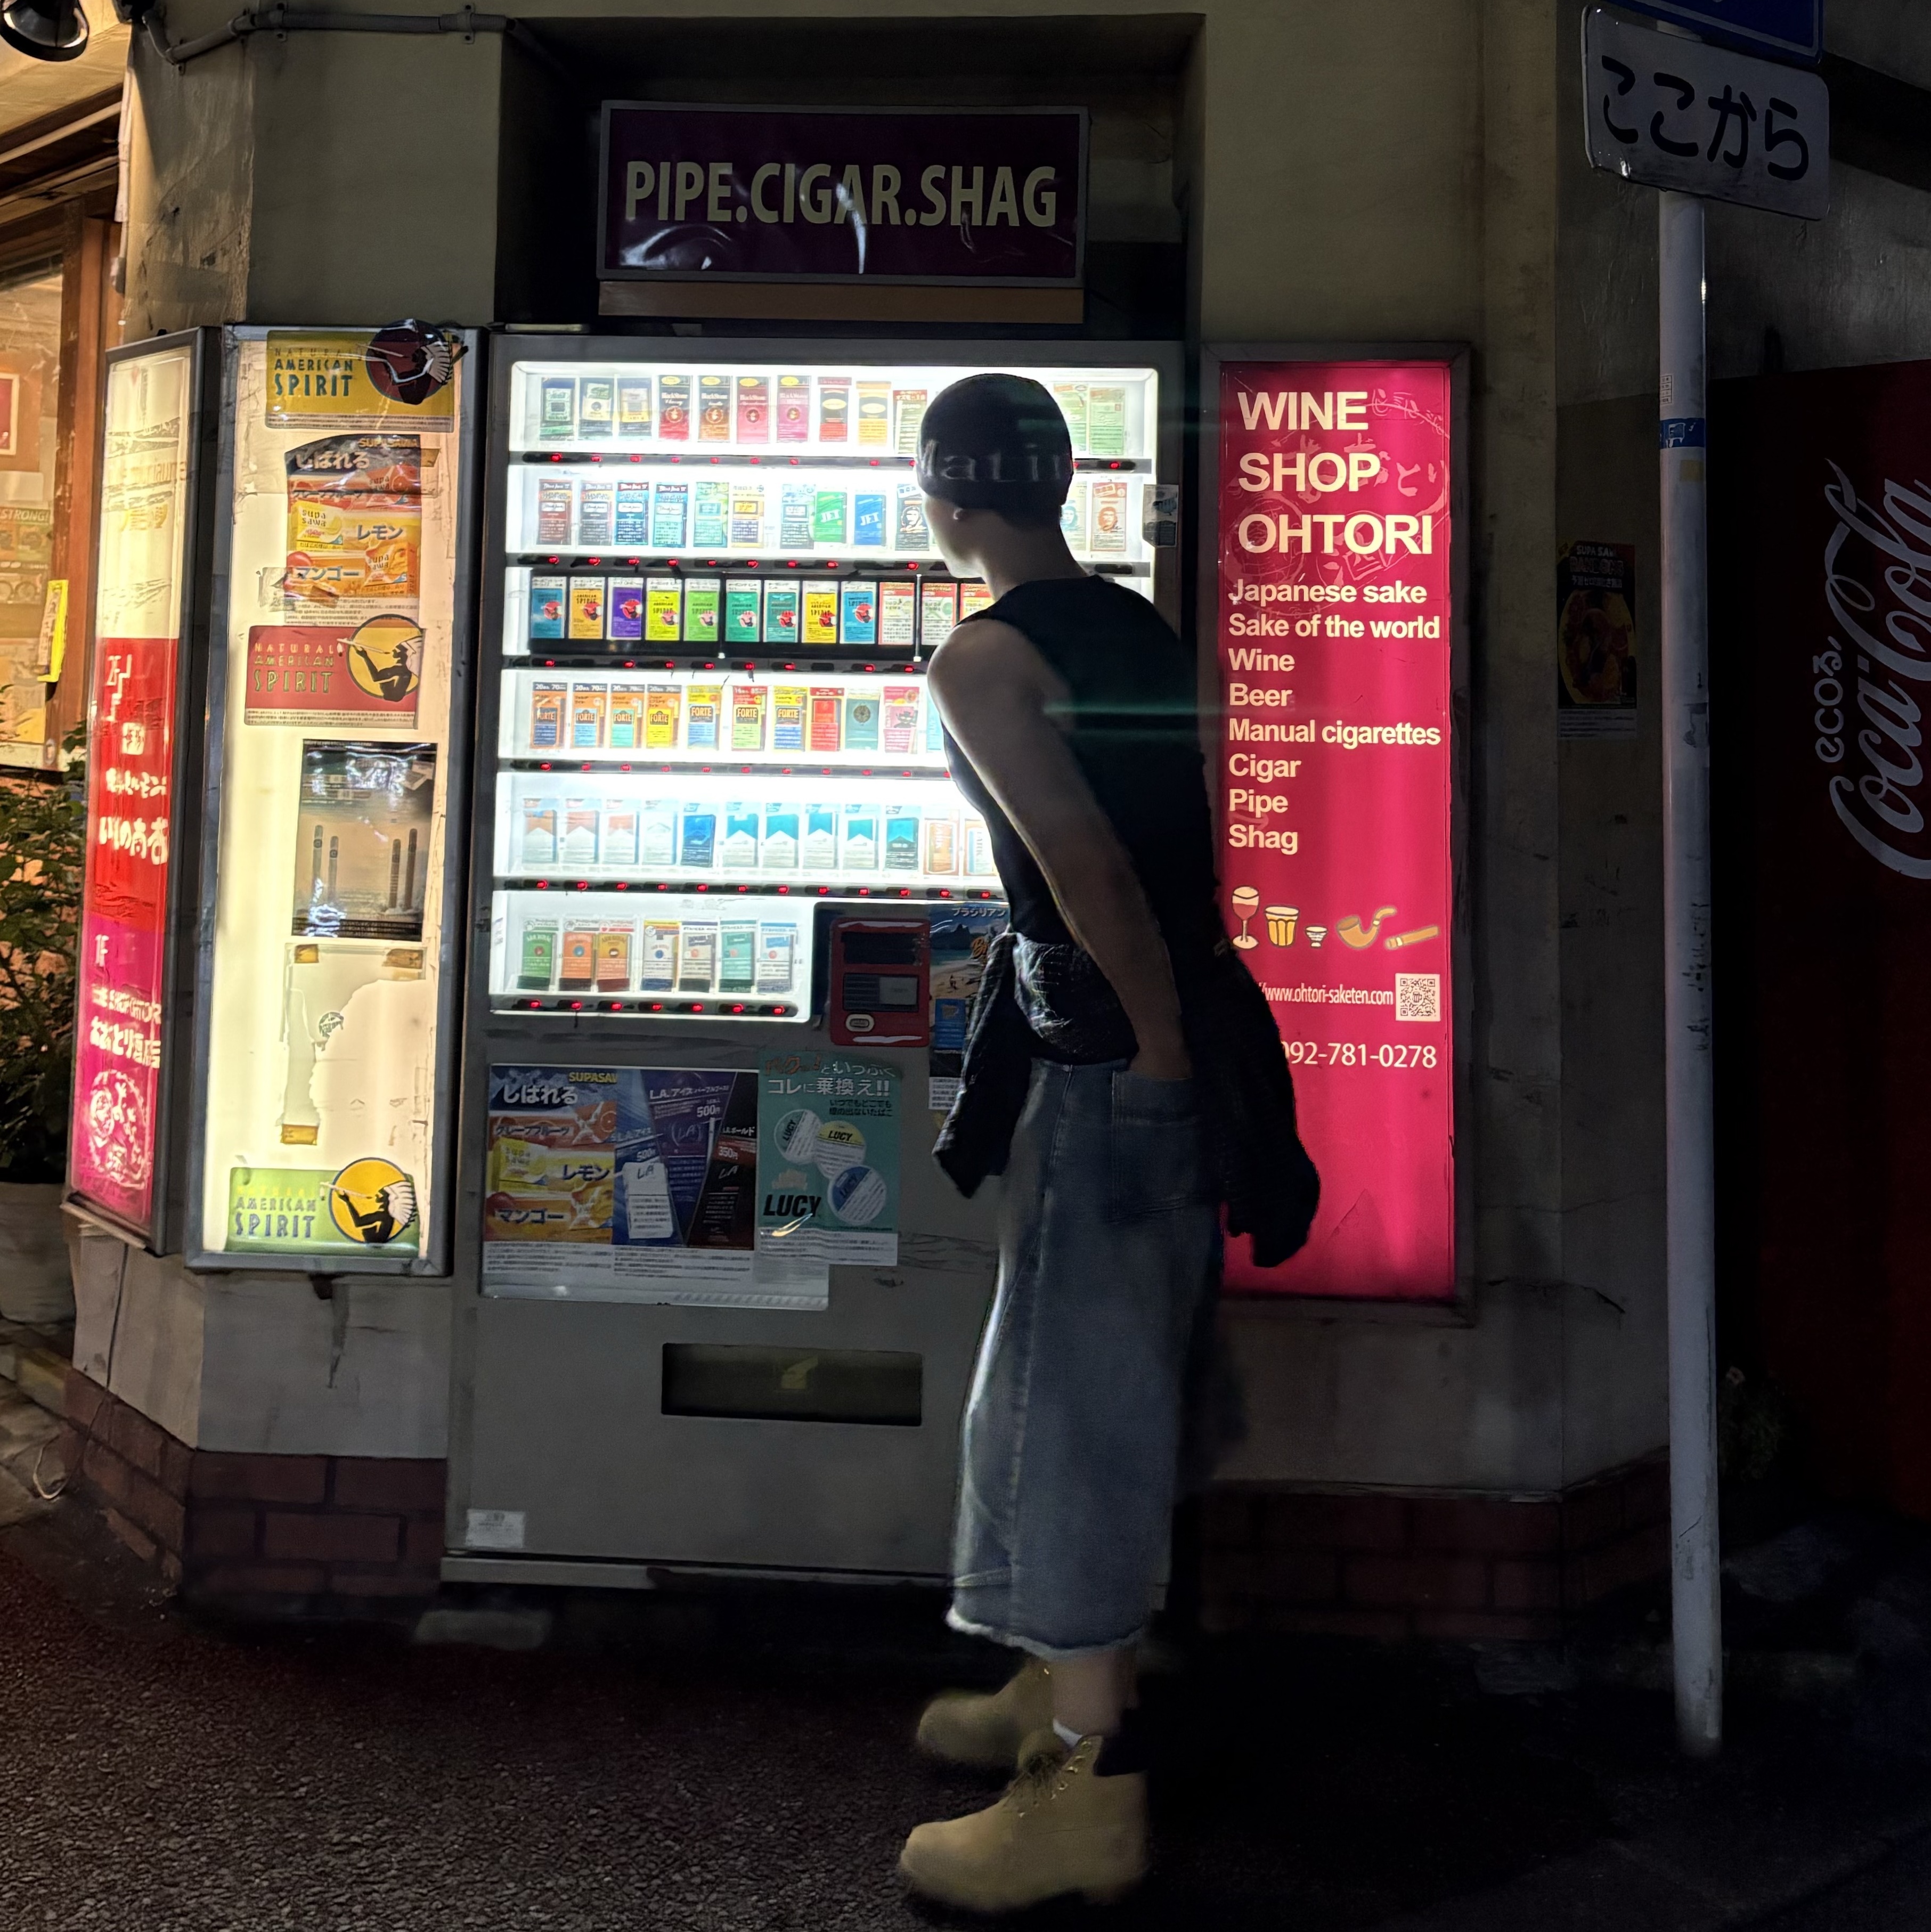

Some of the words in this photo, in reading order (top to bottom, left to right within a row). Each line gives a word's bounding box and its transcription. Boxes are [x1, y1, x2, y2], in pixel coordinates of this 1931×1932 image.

[1601, 55, 1810, 181] ここから
[625, 160, 1057, 227] PIPE.CIGAR.SHAG
[274, 358, 353, 372] AMERICAN
[274, 374, 353, 397] SPIRIT
[1238, 392, 1369, 430] WINE
[295, 450, 370, 470] しばれる
[1239, 452, 1381, 492] SHOP
[302, 509, 327, 520] supa
[302, 517, 327, 527] sawa
[820, 509, 841, 523] JET
[860, 512, 879, 526] JET
[357, 524, 403, 541] レモン
[1238, 513, 1433, 555] OHTORI
[295, 565, 360, 582] マンゴー
[1228, 580, 1357, 607] Japanese
[1363, 580, 1428, 604] sake
[1228, 613, 1289, 638] Sake
[1296, 615, 1321, 638] of
[1325, 616, 1365, 638] the
[1371, 616, 1440, 639] world
[255, 643, 335, 655] NATURAL
[254, 655, 335, 668] AMERICAN
[1228, 648, 1296, 672] Wine
[1824, 458, 1931, 880] Coca-Cola
[254, 670, 333, 694] SPIRIT
[1229, 682, 1293, 707] Beer
[576, 713, 594, 721] FORTE
[614, 713, 632, 722] FORTE
[650, 713, 669, 722] FORTE
[691, 706, 712, 716] FORTE
[737, 707, 757, 718] FORTE
[778, 708, 799, 718] FORTE
[1229, 719, 1315, 743] Manual
[1322, 721, 1441, 750] cigarettes
[1228, 753, 1301, 782] Cigar
[1229, 788, 1289, 818] Pipe
[1228, 824, 1299, 855] Shag
[503, 1085, 578, 1104] しばれる
[768, 1077, 890, 1097] コレに乗換え!!
[696, 1105, 721, 1118] 500円
[829, 1099, 893, 1108] いつでもどこでも
[783, 1119, 797, 1142] LUCY
[828, 1130, 853, 1142] LUCY
[718, 1146, 739, 1161] 350円
[562, 1164, 610, 1181] レモン
[235, 1196, 316, 1212] AMERICAN
[763, 1194, 822, 1218] LUCY
[235, 1211, 315, 1238] SPIRIT
[497, 1208, 565, 1225] マンゴー
